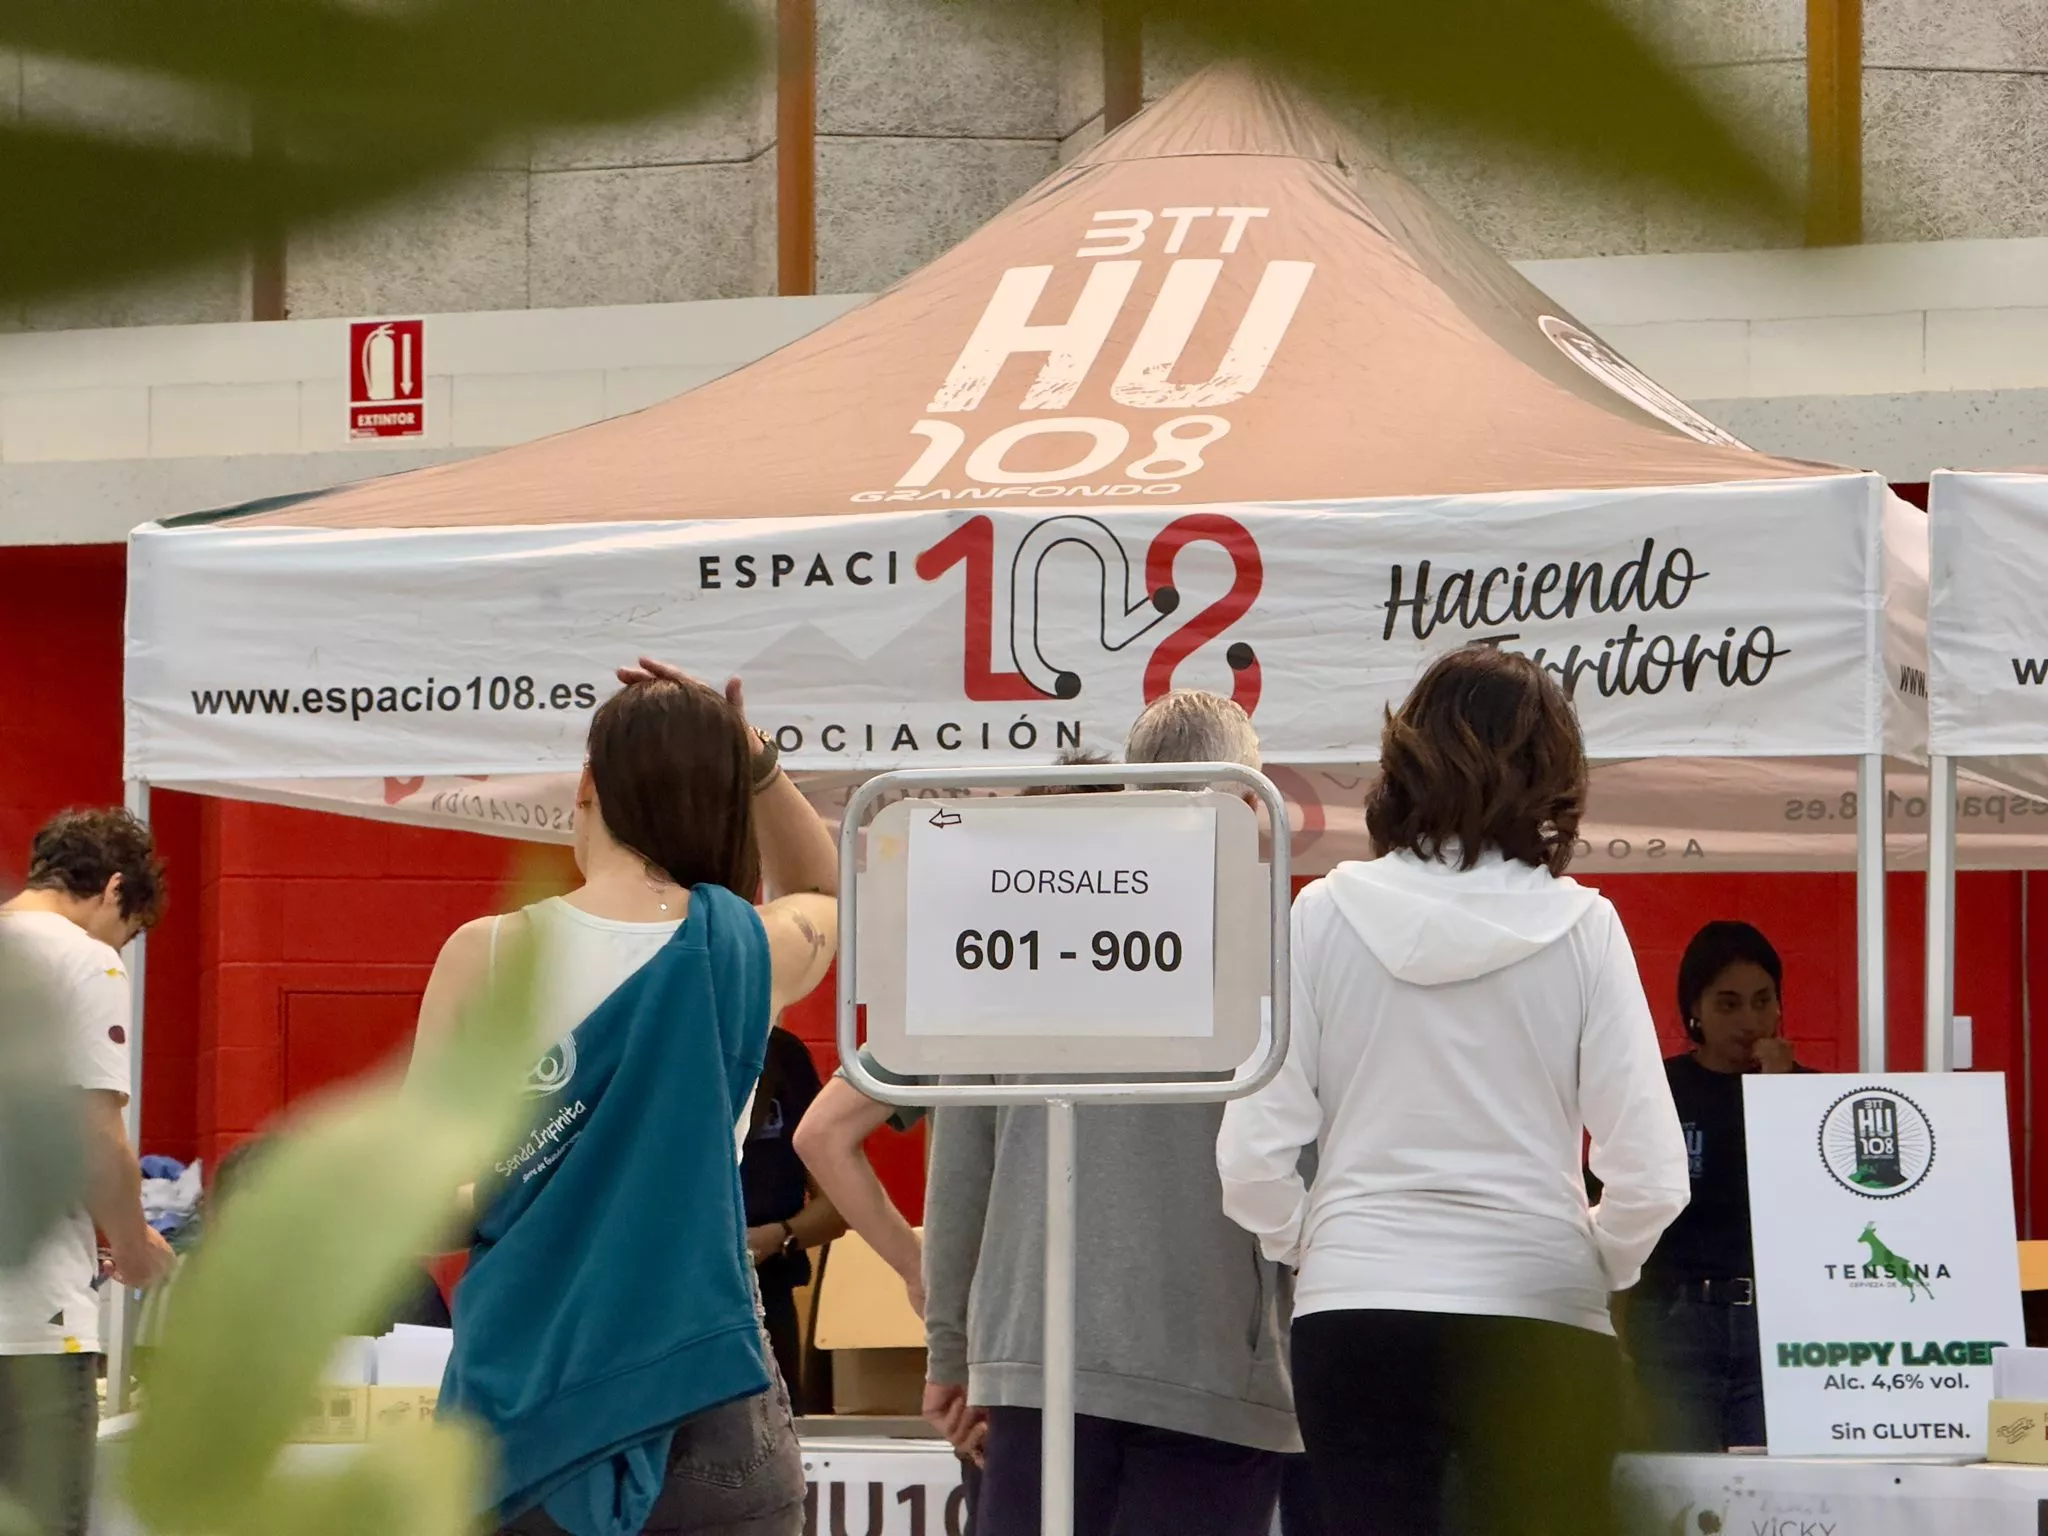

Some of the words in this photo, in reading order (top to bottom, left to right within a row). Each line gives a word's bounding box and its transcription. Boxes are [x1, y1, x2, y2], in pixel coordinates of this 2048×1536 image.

[1076, 206, 1270, 258] BTT
[926, 258, 1316, 412] HU
[357, 412, 416, 427] EXTINTOR
[894, 414, 1232, 488] 108
[849, 482, 1182, 503] GRANFONDO
[1382, 537, 1711, 641] Haciendo
[191, 675, 597, 721] www.espacio108.es
[775, 714, 1083, 753] OCIACIÓN
[991, 869, 1150, 895] DORSALES
[955, 928, 1041, 971] 601
[1091, 930, 1183, 972] 900
[1857, 1108, 1894, 1137] HU
[494, 1142, 537, 1178] Senda
[529, 1099, 588, 1150] Infinita
[1859, 1137, 1895, 1155] 108
[1824, 1263, 1952, 1280] TENSINA
[1777, 1342, 1895, 1368] HOPPY
[1901, 1341, 2010, 1367] LAGE
[1823, 1374, 1866, 1390] Alc.
[1871, 1373, 1925, 1393] 4,6%
[1930, 1373, 1970, 1389] vol.
[1830, 1423, 1866, 1440] Sin
[1872, 1422, 1971, 1440] GLUTEN.
